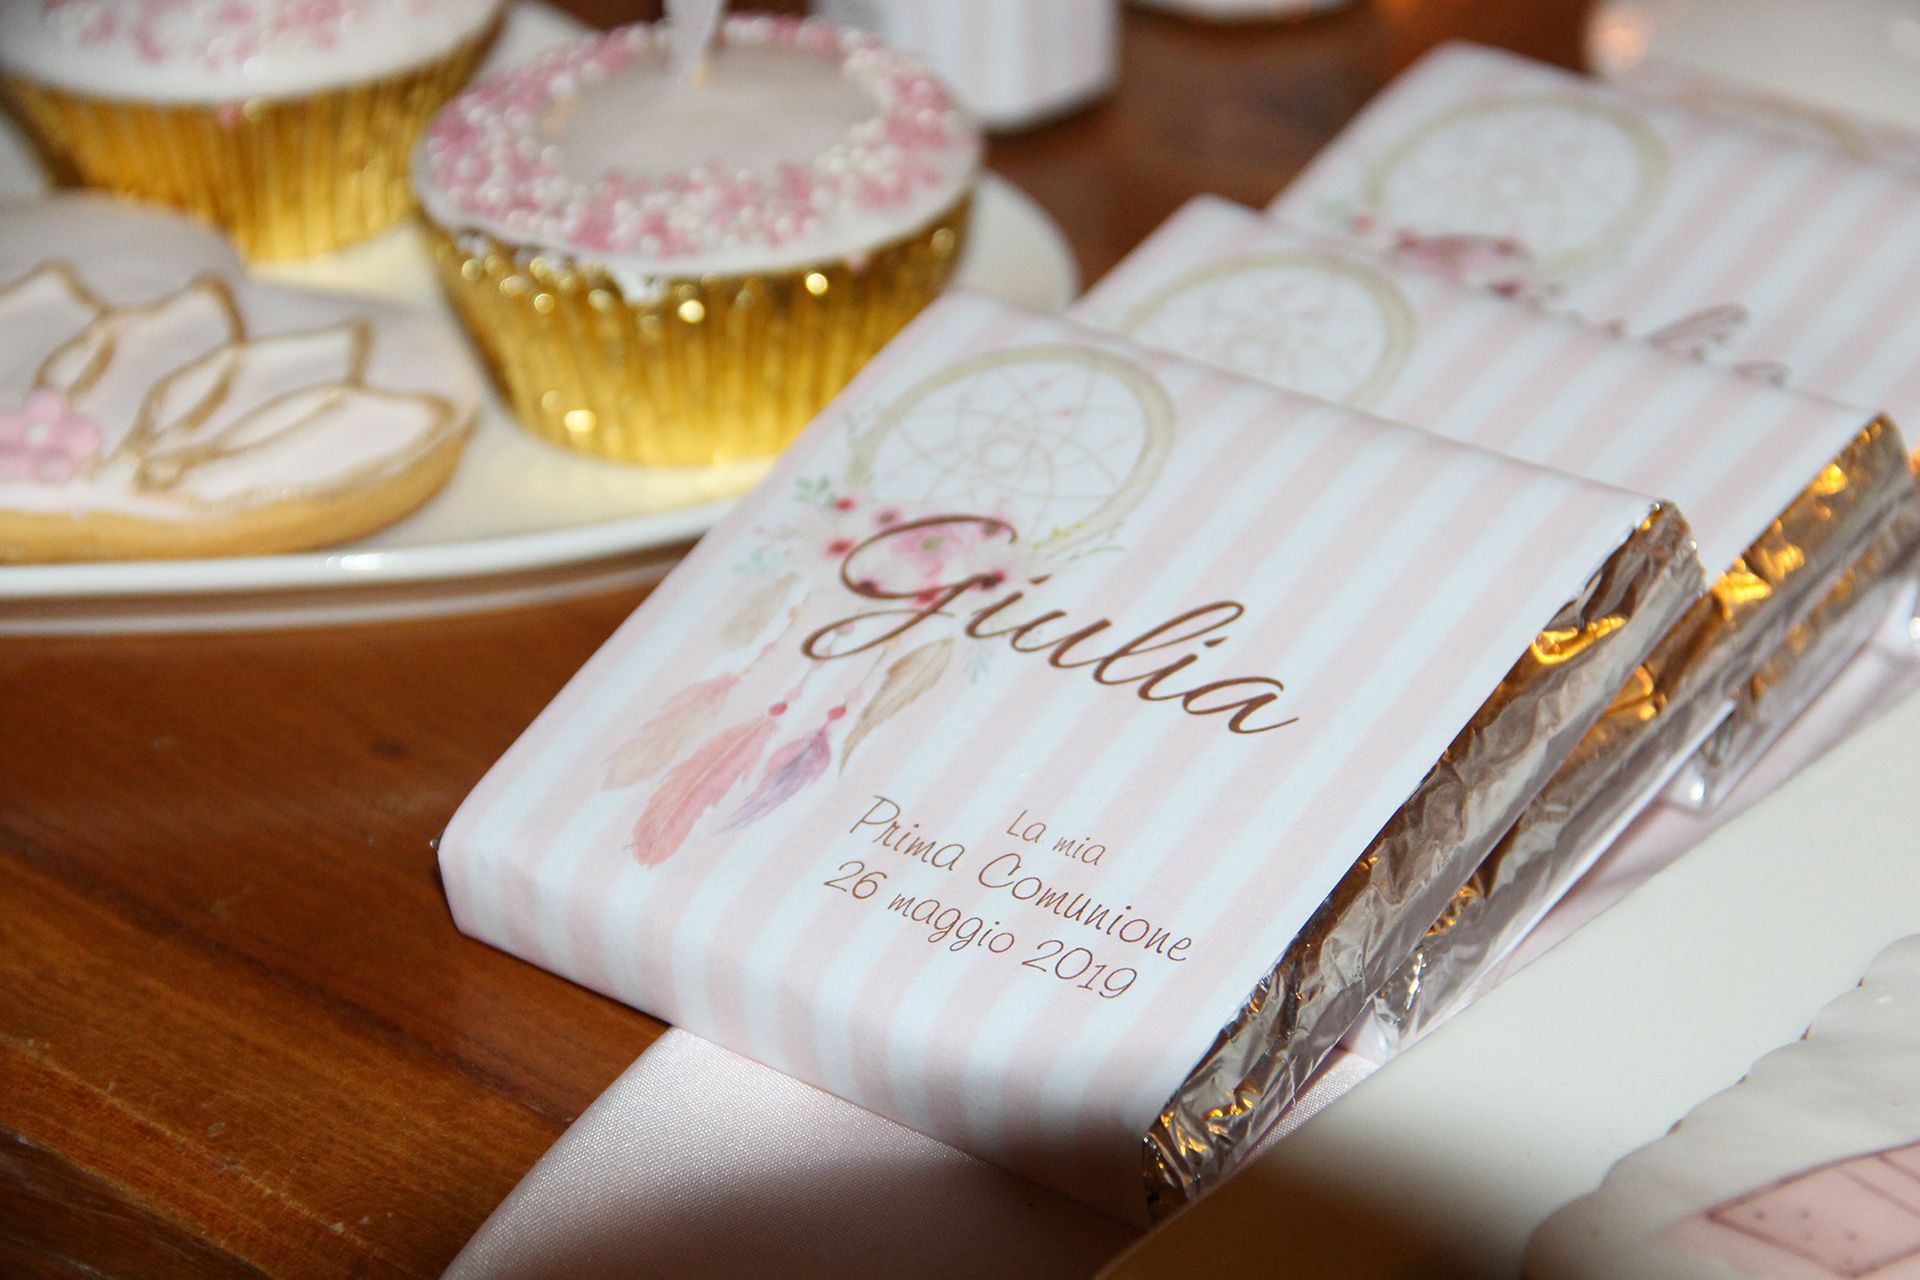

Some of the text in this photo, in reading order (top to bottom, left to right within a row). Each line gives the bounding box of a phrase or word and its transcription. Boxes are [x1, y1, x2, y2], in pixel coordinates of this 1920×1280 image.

[800, 513, 1299, 735] Giulia
[848, 795, 1193, 962] Prima Comunione
[1005, 809, 1107, 867] La mia
[823, 860, 1138, 999] 26 maggio 2019
